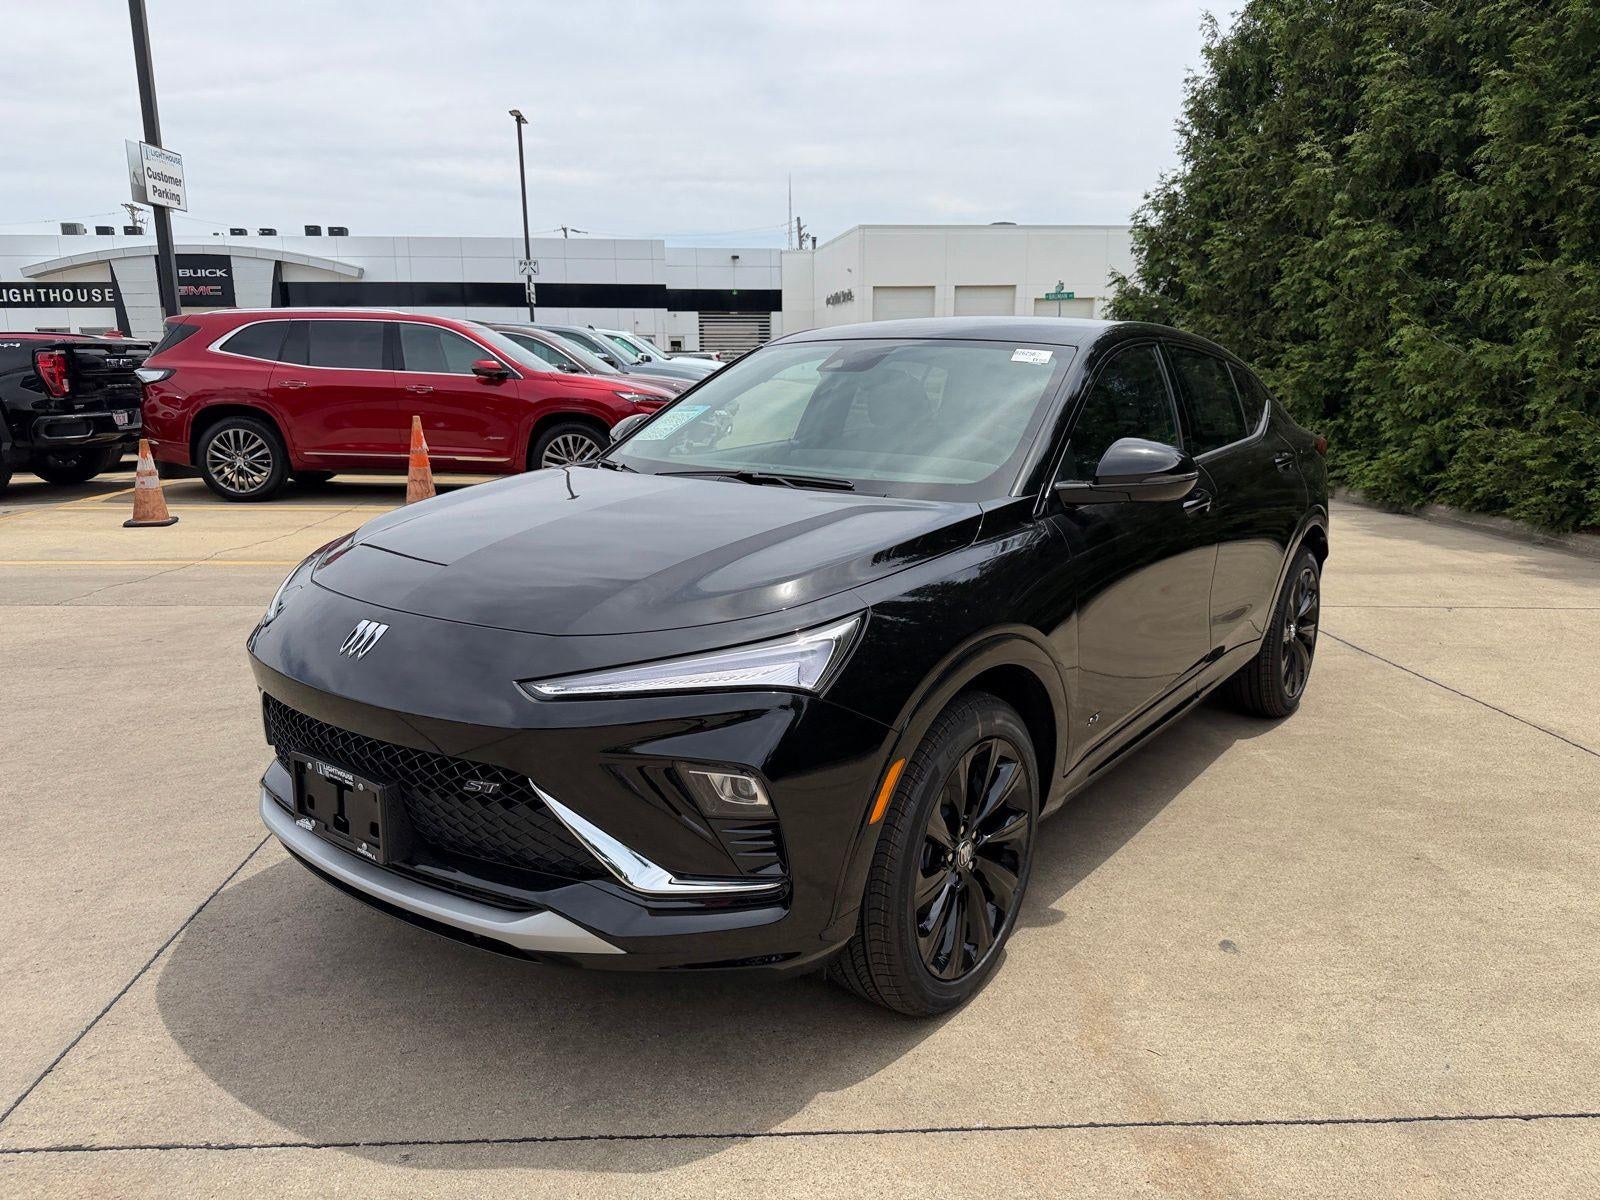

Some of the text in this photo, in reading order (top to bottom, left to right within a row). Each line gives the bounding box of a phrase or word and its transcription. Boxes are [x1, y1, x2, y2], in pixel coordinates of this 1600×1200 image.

[146, 166, 182, 187] Customer
[152, 184, 181, 206] Parking
[178, 268, 228, 278] BUICK
[463, 780, 499, 793] ST
